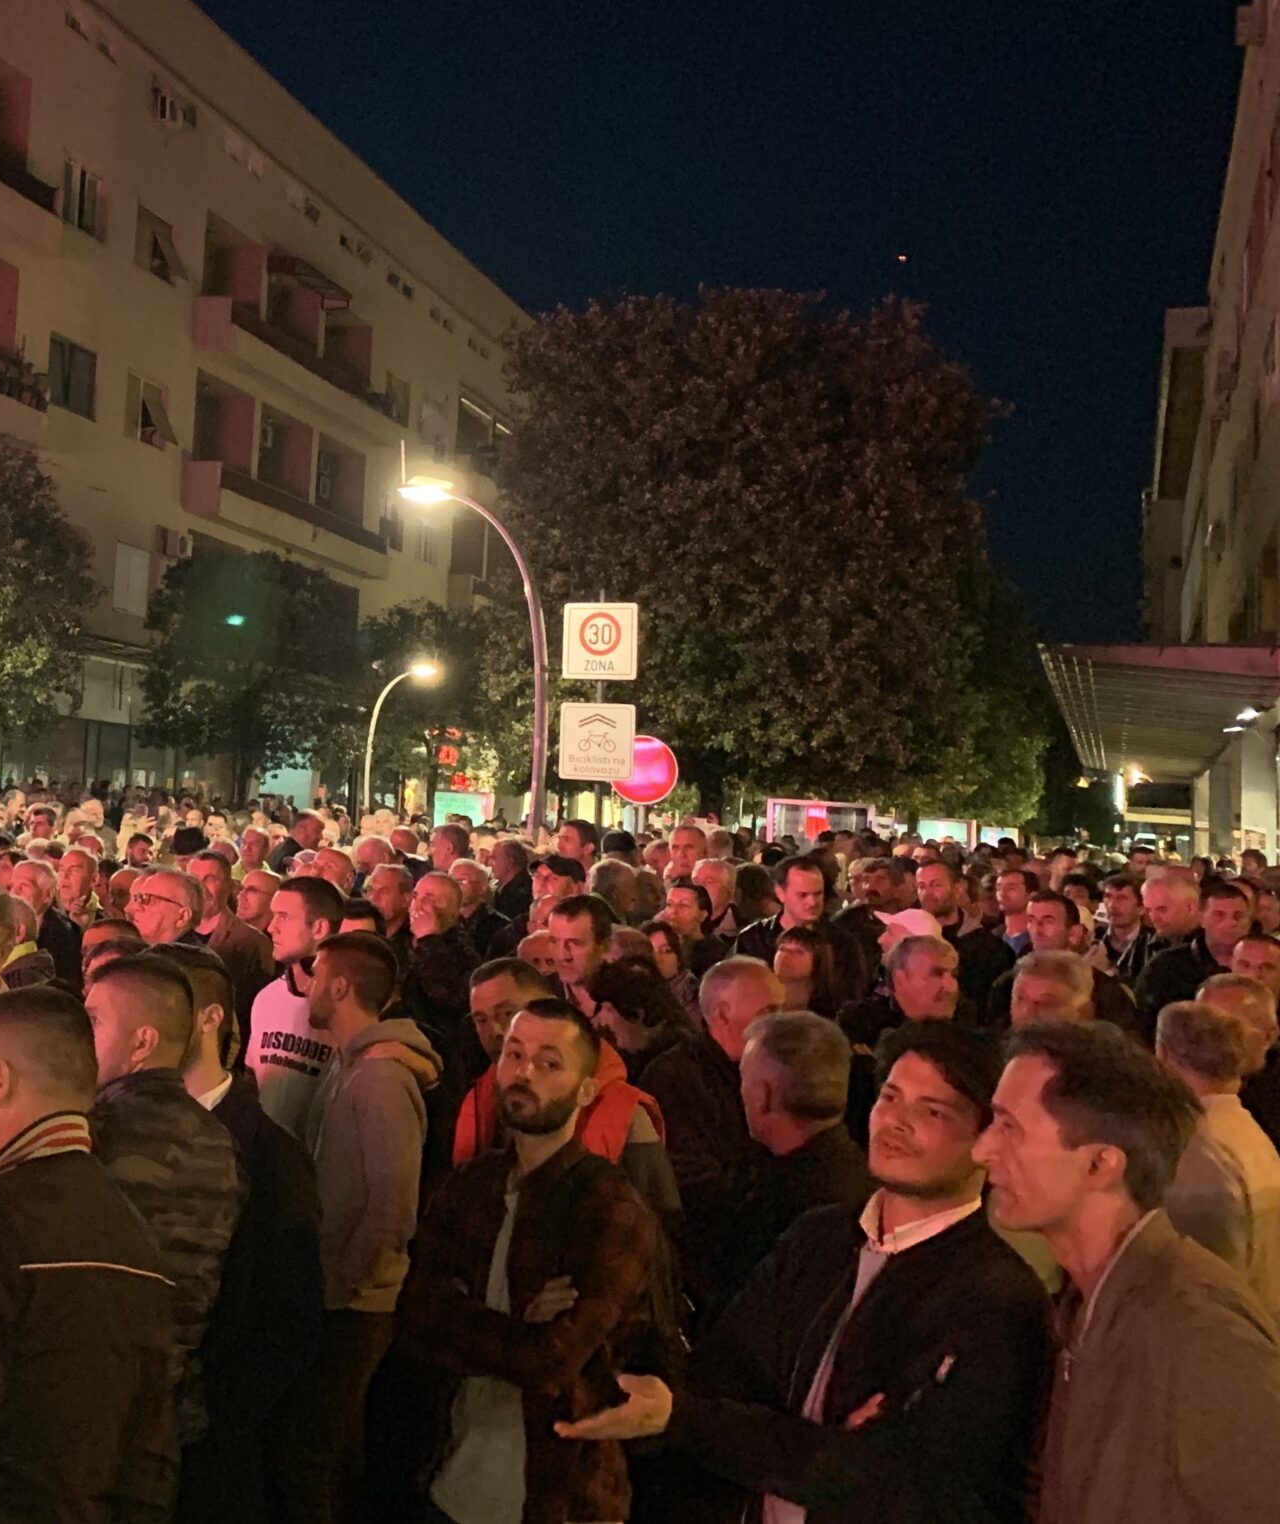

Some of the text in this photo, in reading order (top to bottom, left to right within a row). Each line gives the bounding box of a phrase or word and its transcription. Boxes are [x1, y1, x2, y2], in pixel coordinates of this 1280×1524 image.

[589, 623, 612, 645] 30
[584, 660, 615, 671] ZONA
[568, 753, 626, 765] Biciklisti na
[573, 763, 620, 775] kolovozu
